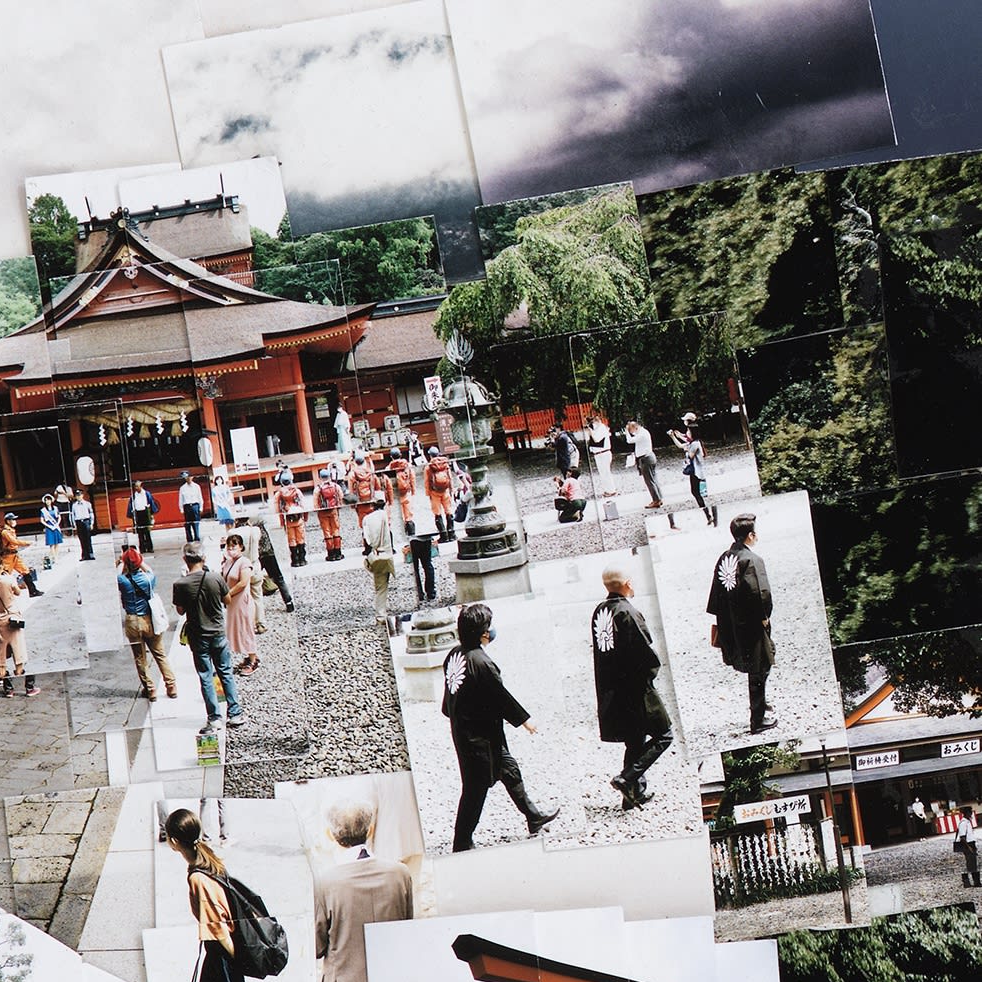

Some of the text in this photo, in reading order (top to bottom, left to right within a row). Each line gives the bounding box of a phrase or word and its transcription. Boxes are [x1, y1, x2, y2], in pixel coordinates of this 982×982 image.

[943, 741, 977, 755] おみくじ
[857, 753, 897, 767] 御祈祷受付
